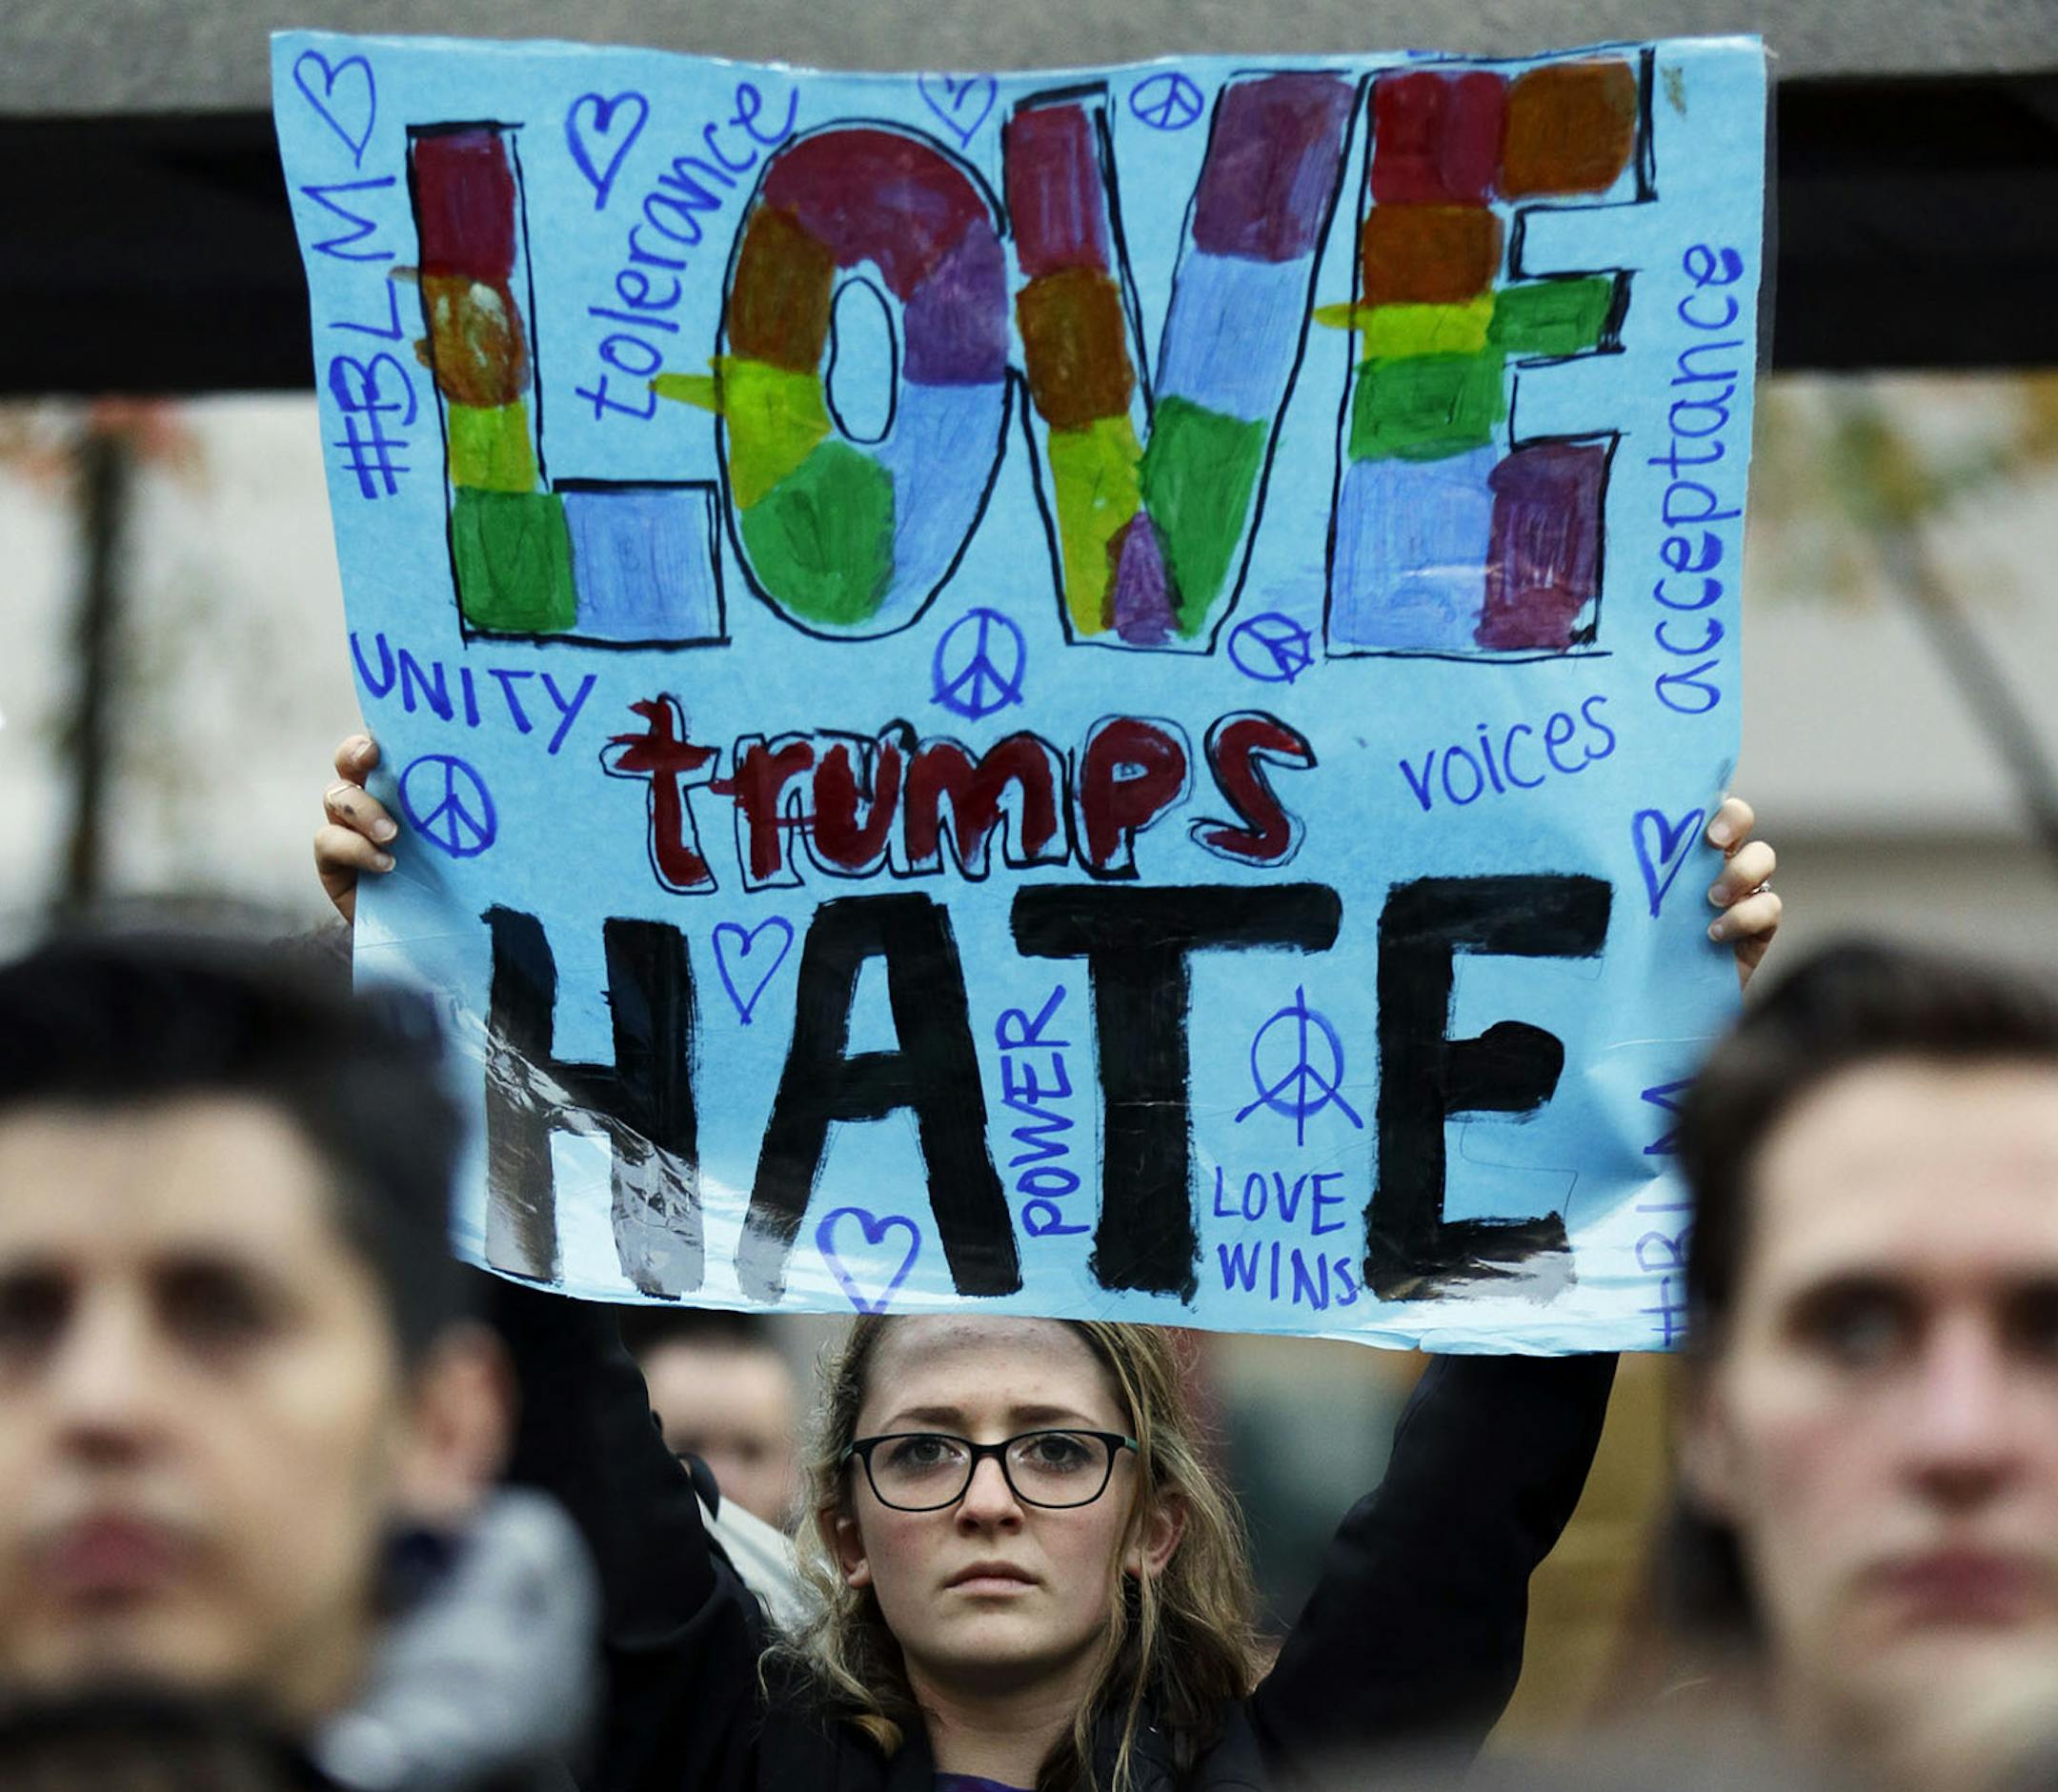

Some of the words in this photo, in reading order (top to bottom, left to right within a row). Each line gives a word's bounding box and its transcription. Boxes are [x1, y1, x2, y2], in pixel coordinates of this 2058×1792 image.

[299, 175, 417, 499] #BLM
[405, 44, 1660, 664] LOVE
[575, 80, 799, 423] tolerance
[1647, 242, 1745, 716] acceptance
[350, 631, 598, 755] UNITY
[1399, 695, 1618, 813] voices
[479, 872, 1614, 1307] HATE
[999, 983, 1091, 1238] POWER
[1212, 1164, 1350, 1237] LOVE
[1216, 1240, 1362, 1311] WINS
